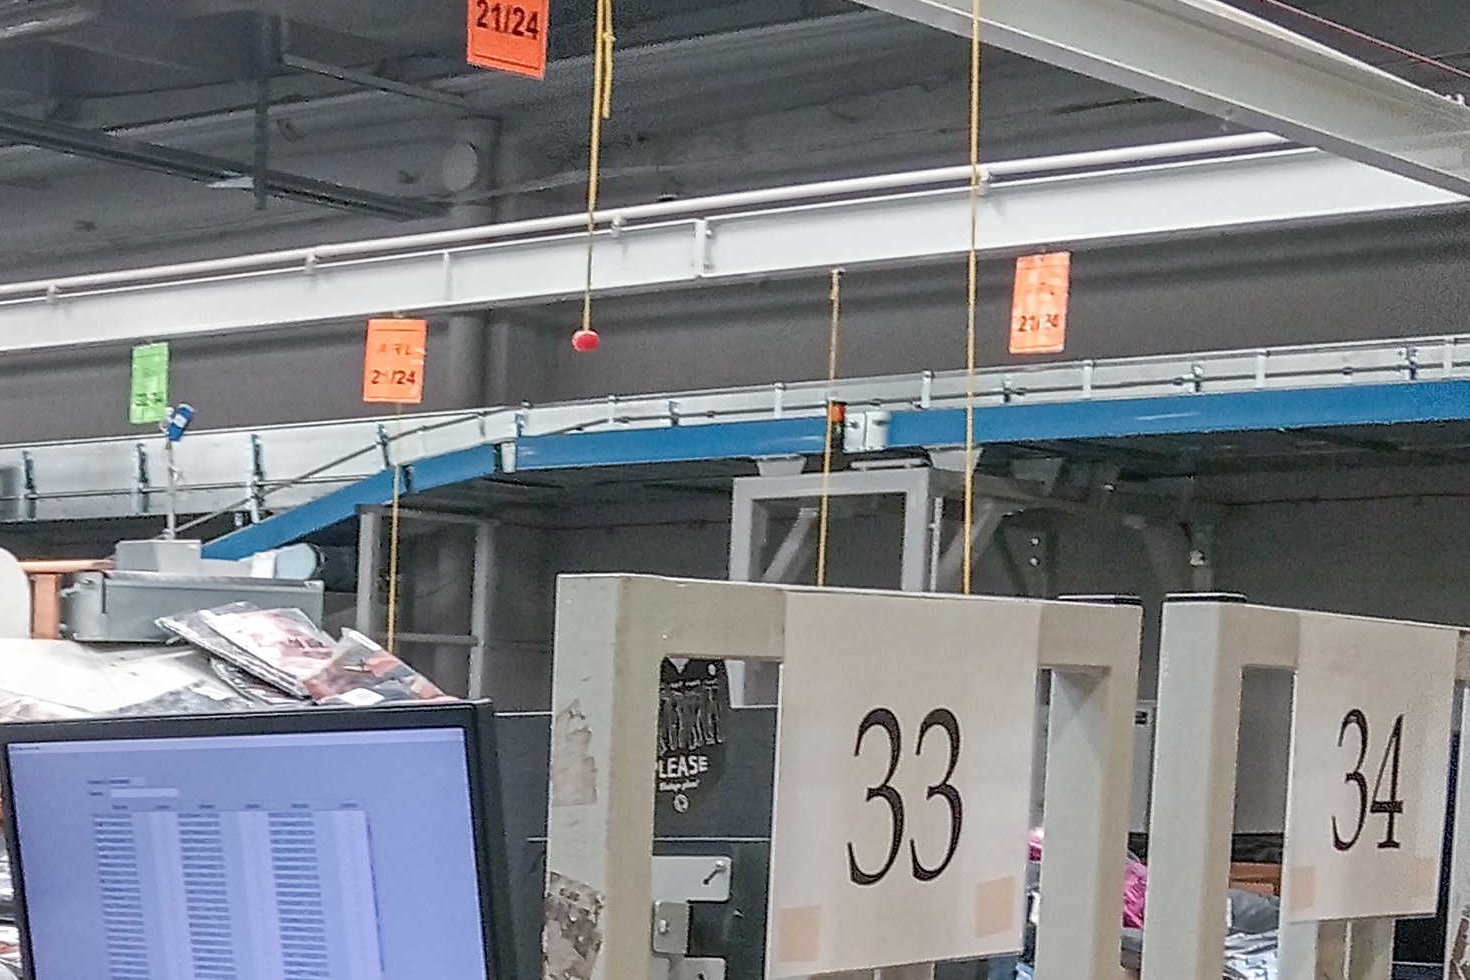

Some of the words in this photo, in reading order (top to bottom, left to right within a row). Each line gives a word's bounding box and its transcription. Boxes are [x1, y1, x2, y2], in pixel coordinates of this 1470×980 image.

[476, 0, 539, 40] 21/24
[658, 755, 709, 778] LEASE
[846, 707, 963, 886] 33
[1331, 708, 1404, 851] 34
